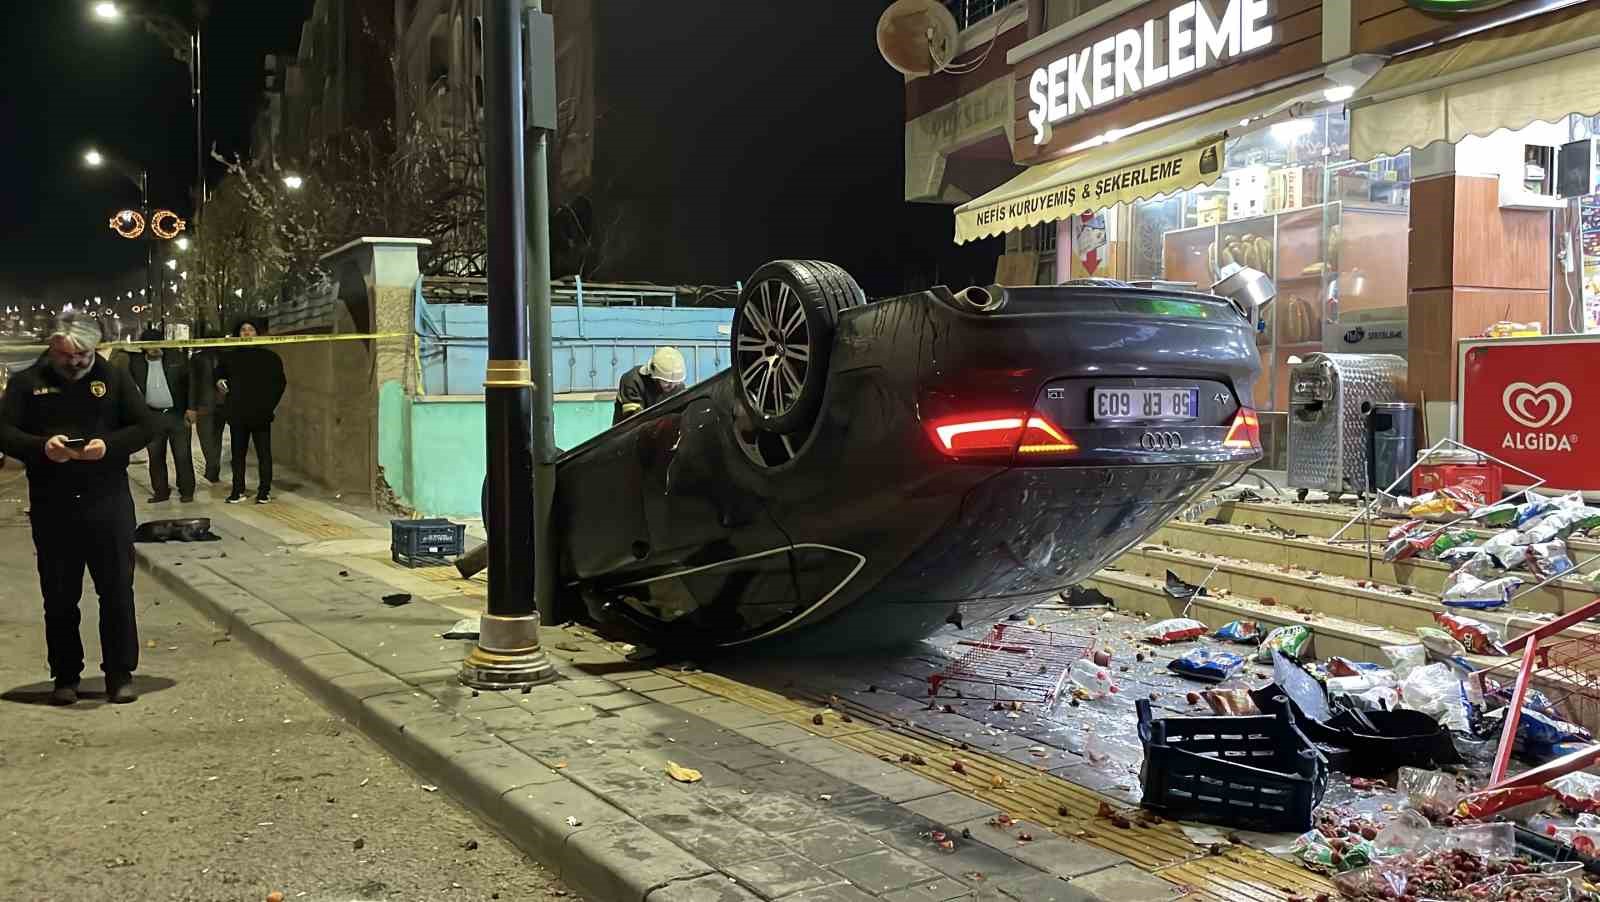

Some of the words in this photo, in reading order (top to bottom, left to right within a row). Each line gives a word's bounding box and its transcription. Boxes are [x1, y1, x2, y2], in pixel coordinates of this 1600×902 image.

[1028, 0, 1273, 145] ŞEKERLEME
[977, 204, 1005, 226] NEFİS
[1009, 186, 1076, 218] KURUYEMİŞ
[1082, 184, 1090, 199] &
[1095, 159, 1183, 200] ŞEKERLEME
[1098, 392, 1131, 416] 603
[1143, 392, 1162, 417] ER
[1173, 392, 1189, 415] 58
